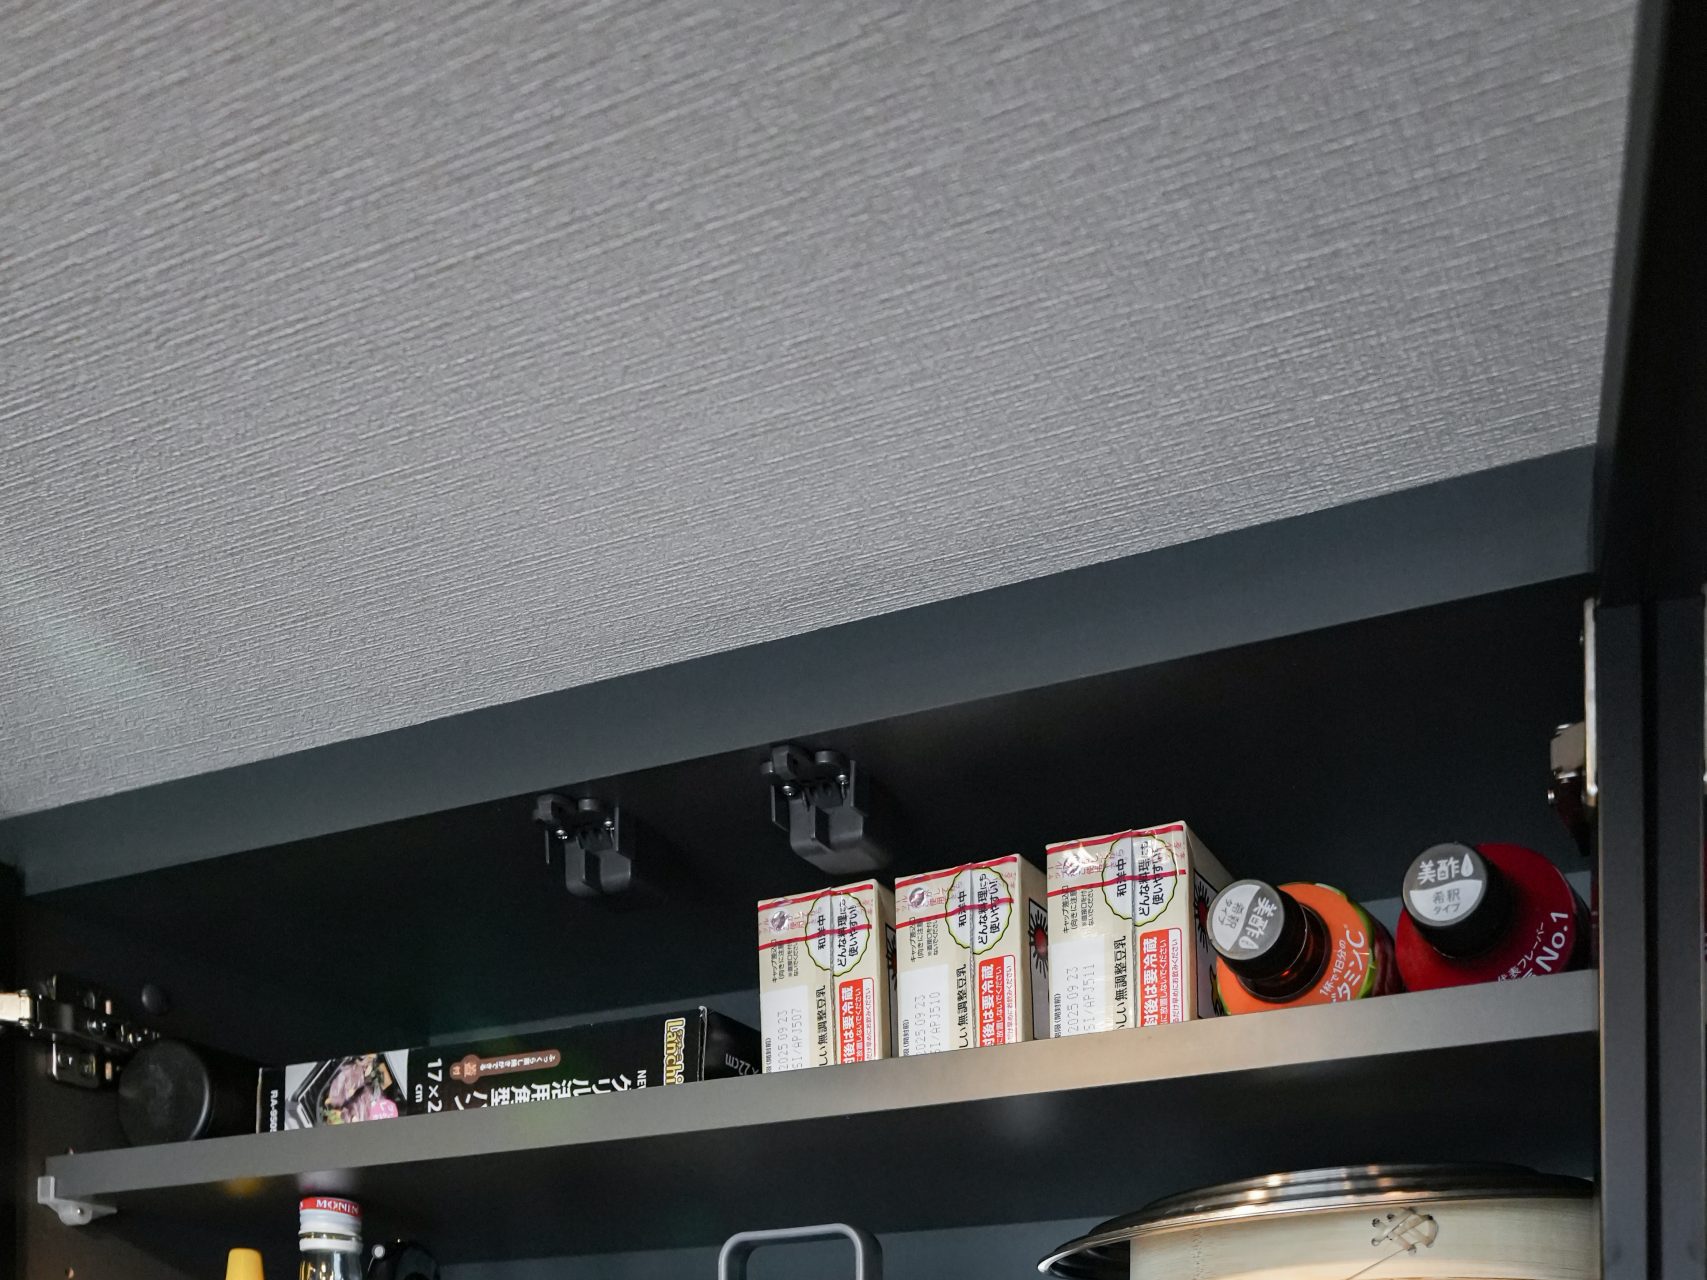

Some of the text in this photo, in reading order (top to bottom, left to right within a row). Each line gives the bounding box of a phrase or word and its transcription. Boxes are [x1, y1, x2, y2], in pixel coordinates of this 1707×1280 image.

[1418, 859, 1462, 885] 美酢
[1244, 898, 1277, 938] 美酢
[1330, 929, 1364, 1004] タミンC
[315, 1199, 359, 1214] MONIN
